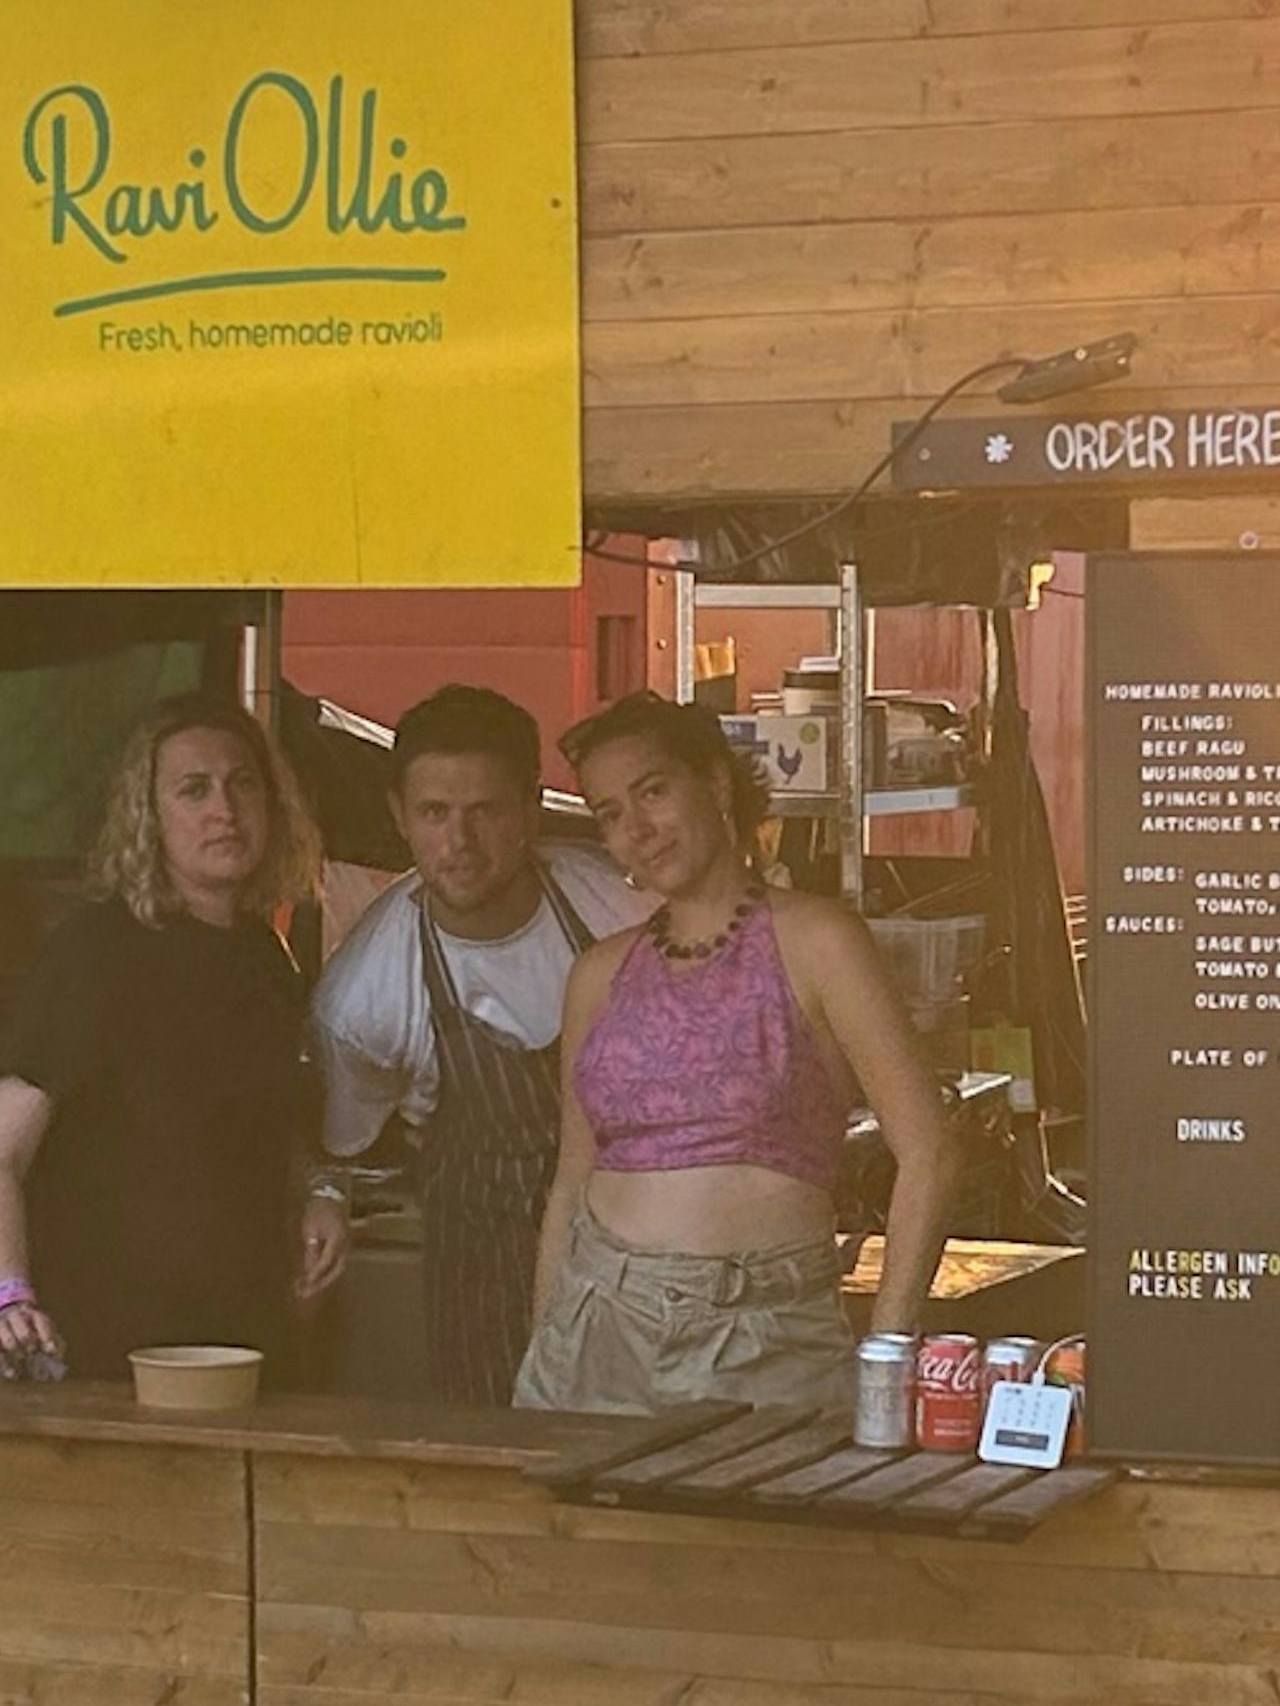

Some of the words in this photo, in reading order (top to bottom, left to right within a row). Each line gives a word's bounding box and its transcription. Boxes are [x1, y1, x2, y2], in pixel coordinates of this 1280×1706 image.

[99, 320, 183, 353] Fresh,
[189, 316, 353, 348] homemade
[361, 313, 444, 344] ravioli
[1045, 415, 1174, 472] ORDER
[1105, 683, 1202, 700] HOMEMADE
[1208, 683, 1280, 699] RAVIOLI
[1141, 741, 1189, 757] BEEF
[1196, 741, 1246, 756] RAGU
[1141, 765, 1240, 782] MUSHROOM
[1246, 765, 1258, 781] &
[1142, 791, 1220, 807] SPINACH
[1227, 791, 1238, 806] &
[1141, 817, 1244, 832] ARTICHOKE
[1250, 816, 1263, 831] &
[1195, 874, 1262, 890] GARLIC
[1195, 937, 1244, 952] SAGE
[1195, 962, 1269, 978] TOMATO
[1195, 994, 1249, 1009] OLIVE
[1170, 1050, 1232, 1066] PLATE
[1243, 1051, 1267, 1066] OF
[1177, 1118, 1246, 1143] DRINKS
[1129, 1250, 1227, 1275] ALLERGEN
[1238, 1252, 1280, 1276] INFO
[1128, 1274, 1202, 1298] PLEASE
[1214, 1277, 1251, 1300] ASK
